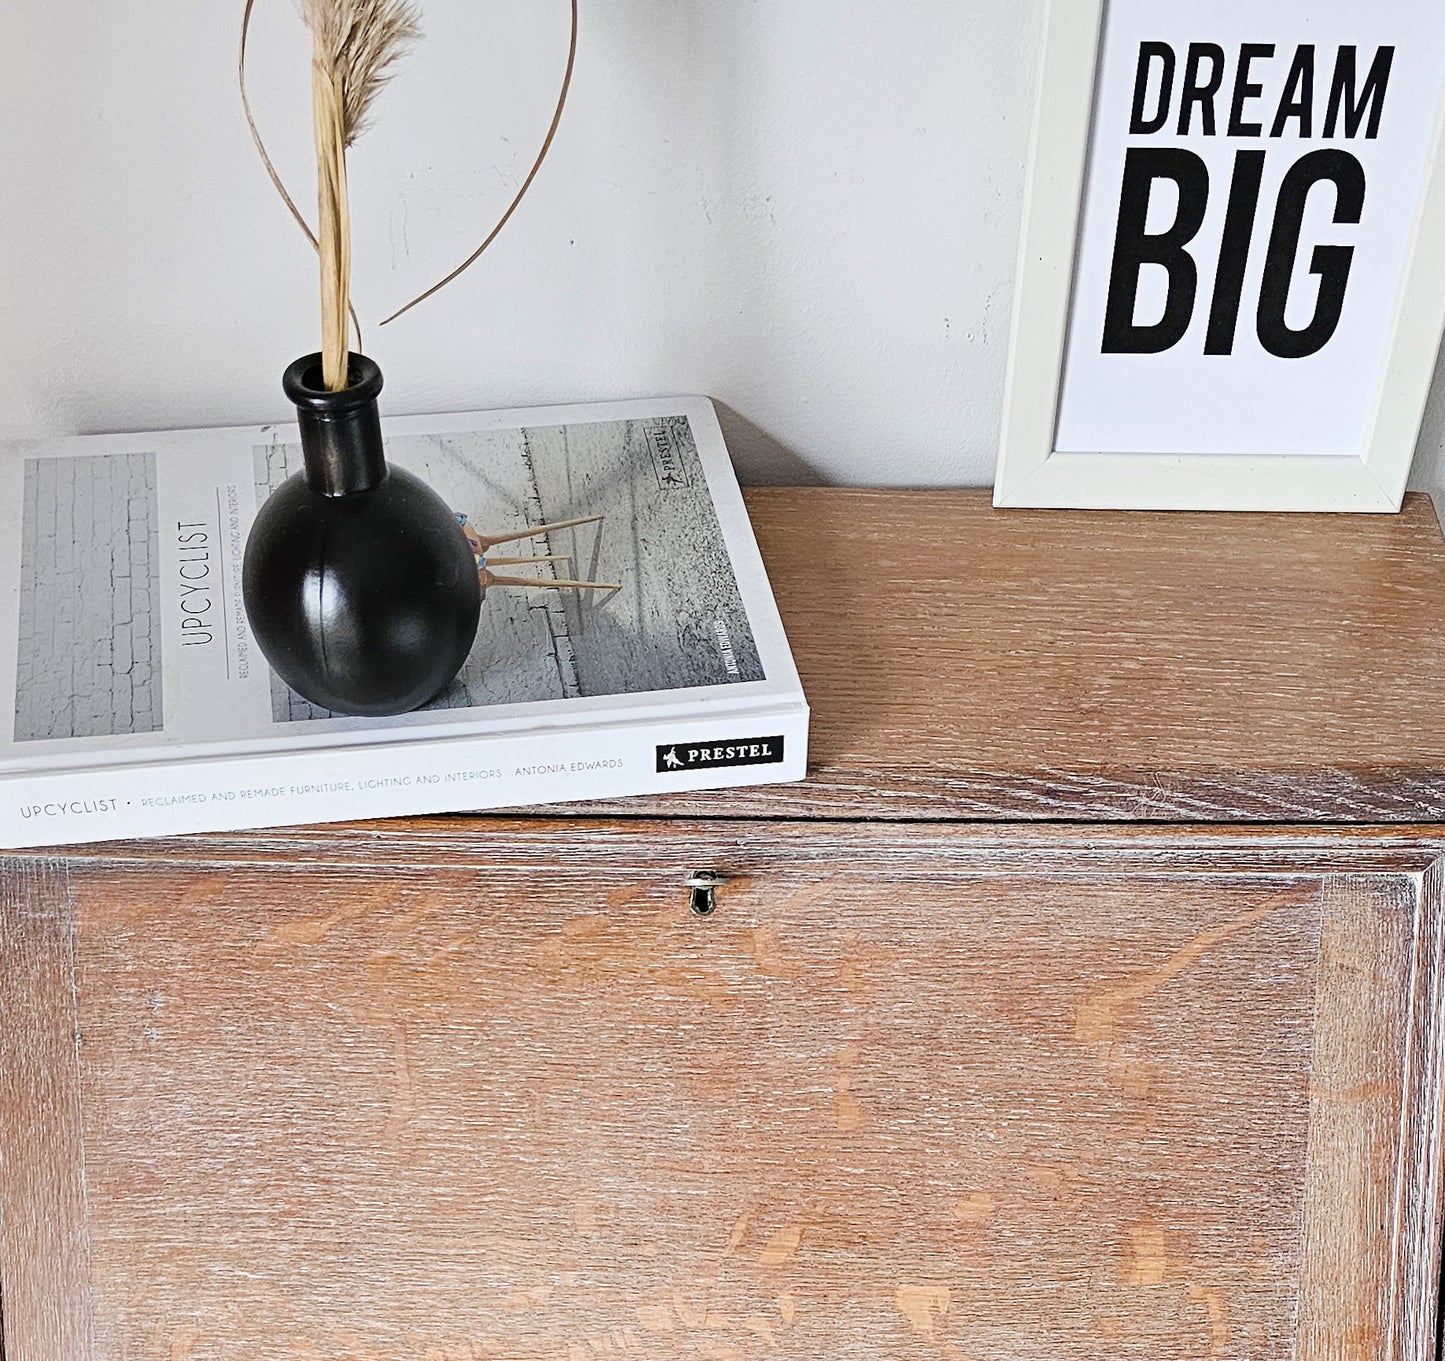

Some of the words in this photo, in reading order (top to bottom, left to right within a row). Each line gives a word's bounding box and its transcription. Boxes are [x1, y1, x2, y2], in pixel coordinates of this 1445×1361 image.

[1129, 41, 1395, 139] DREAM
[1101, 147, 1366, 358] BIG
[653, 430, 675, 471] PRESTEL
[178, 521, 213, 646] UPCYCLIST
[237, 626, 247, 640] AND
[237, 642, 249, 680] RECLAIMED
[687, 744, 772, 762] PRESTEL
[20, 798, 117, 819] UPCYCLIST
[141, 793, 207, 808] RECLAIMED
[211, 791, 236, 802] AND
[240, 787, 286, 800] REMADE
[358, 776, 412, 790] LIGHTING
[415, 773, 440, 784] AND
[444, 768, 502, 782] INTERIORS
[514, 764, 567, 776] ANTONIA
[570, 758, 624, 772] EDWARDS
